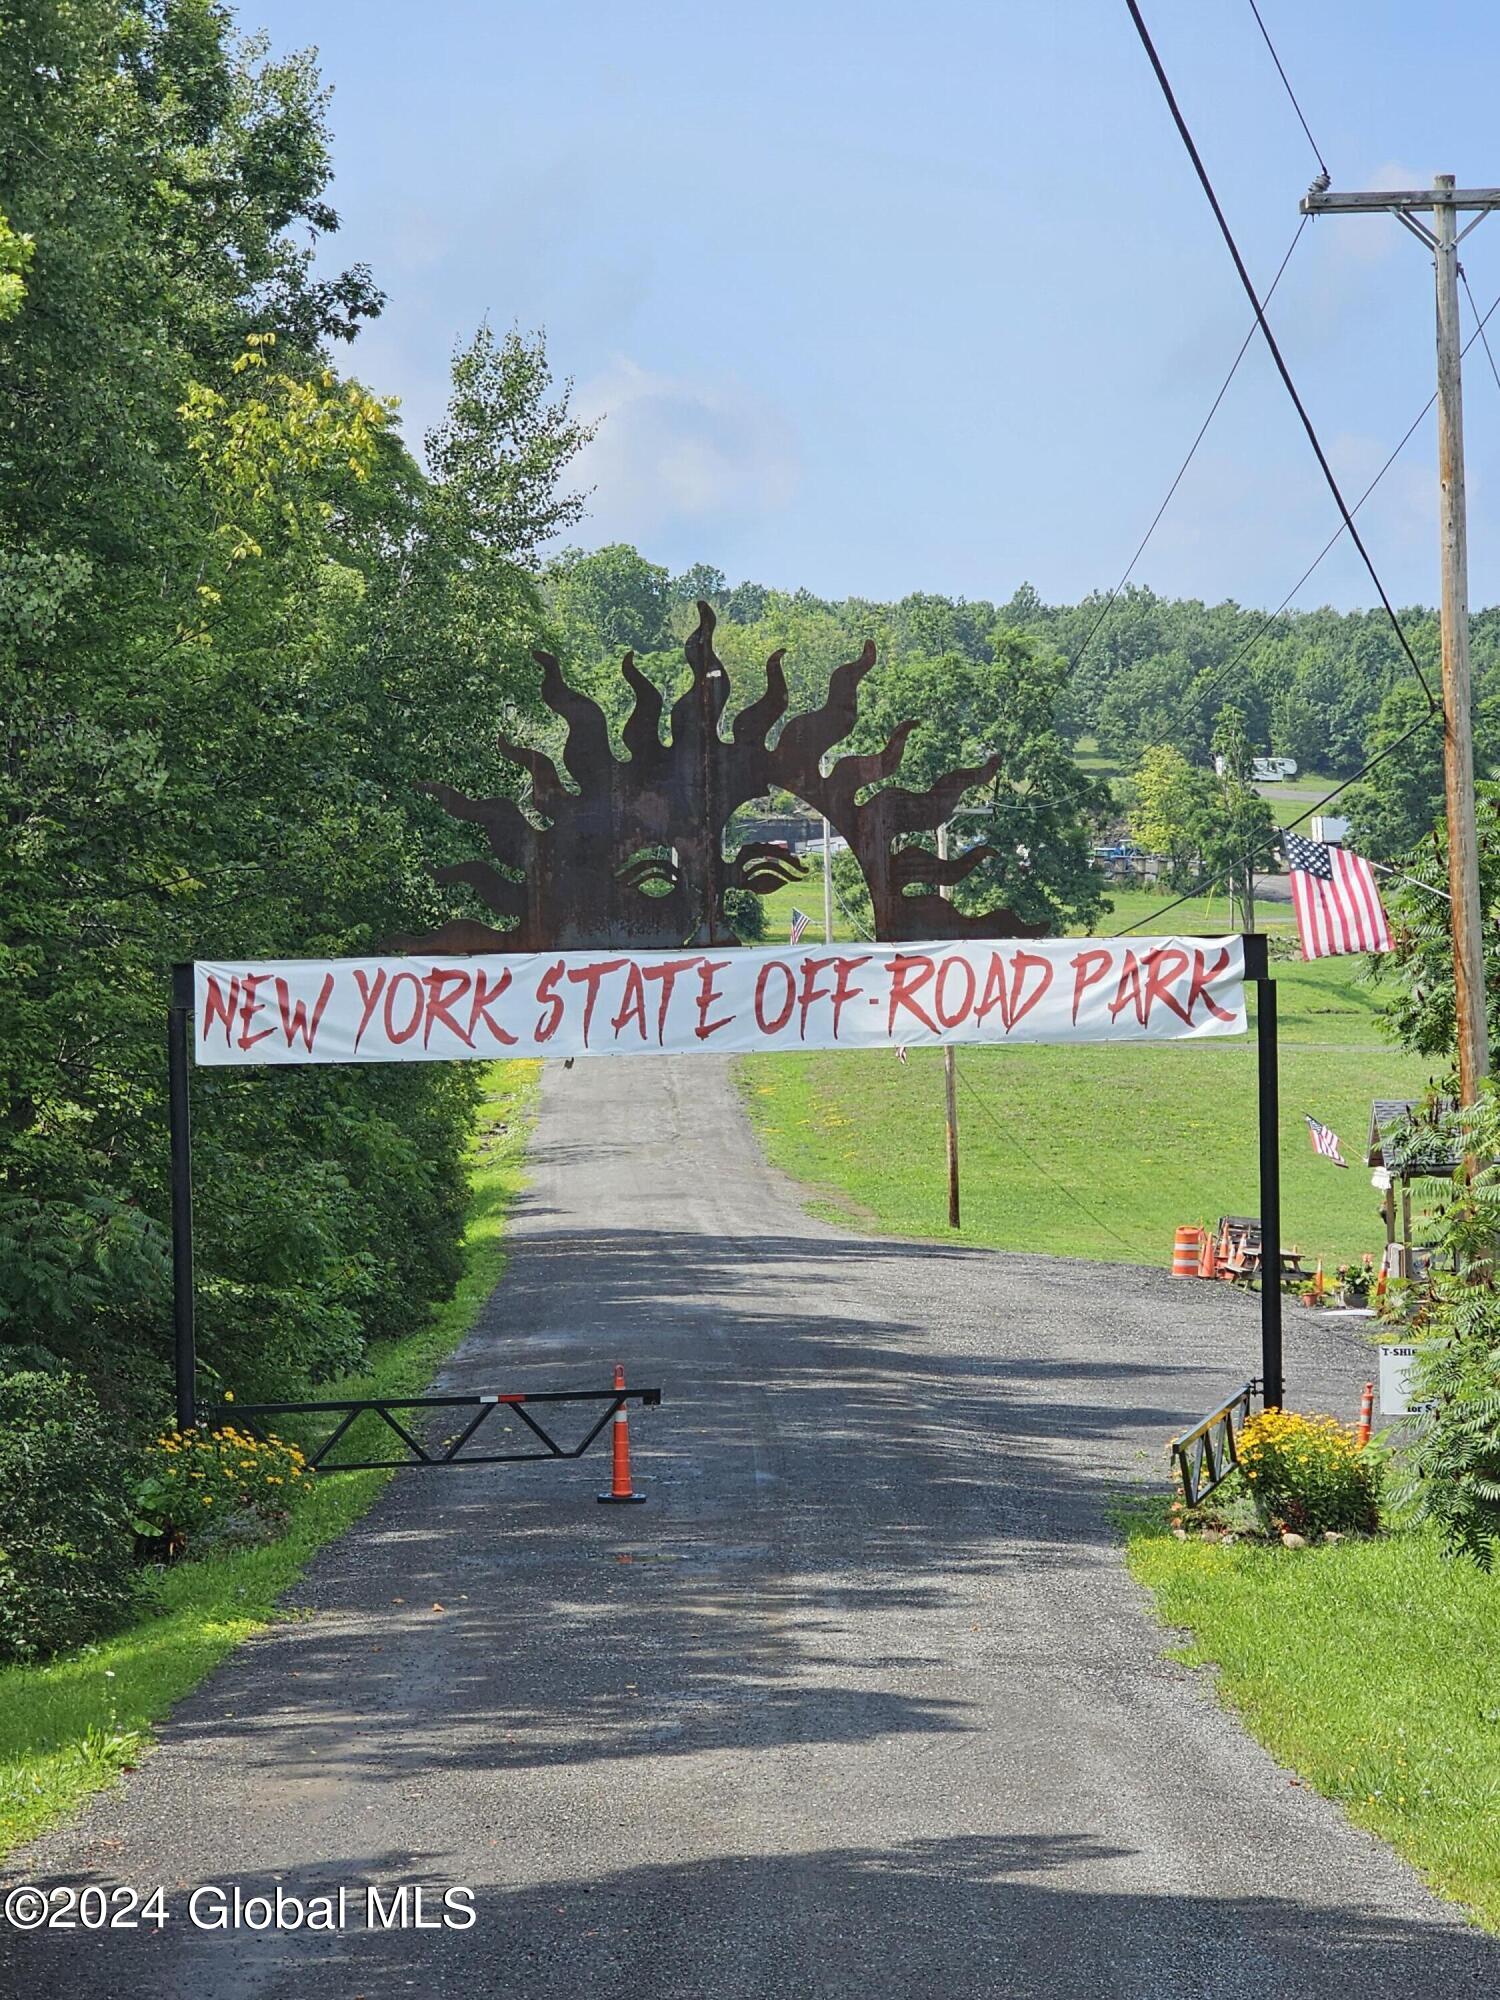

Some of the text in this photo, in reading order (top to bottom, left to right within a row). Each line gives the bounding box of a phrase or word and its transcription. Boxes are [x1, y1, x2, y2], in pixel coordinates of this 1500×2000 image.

[203, 946, 1238, 1054] NEW YORK STATE OFF-ROAD PARK
